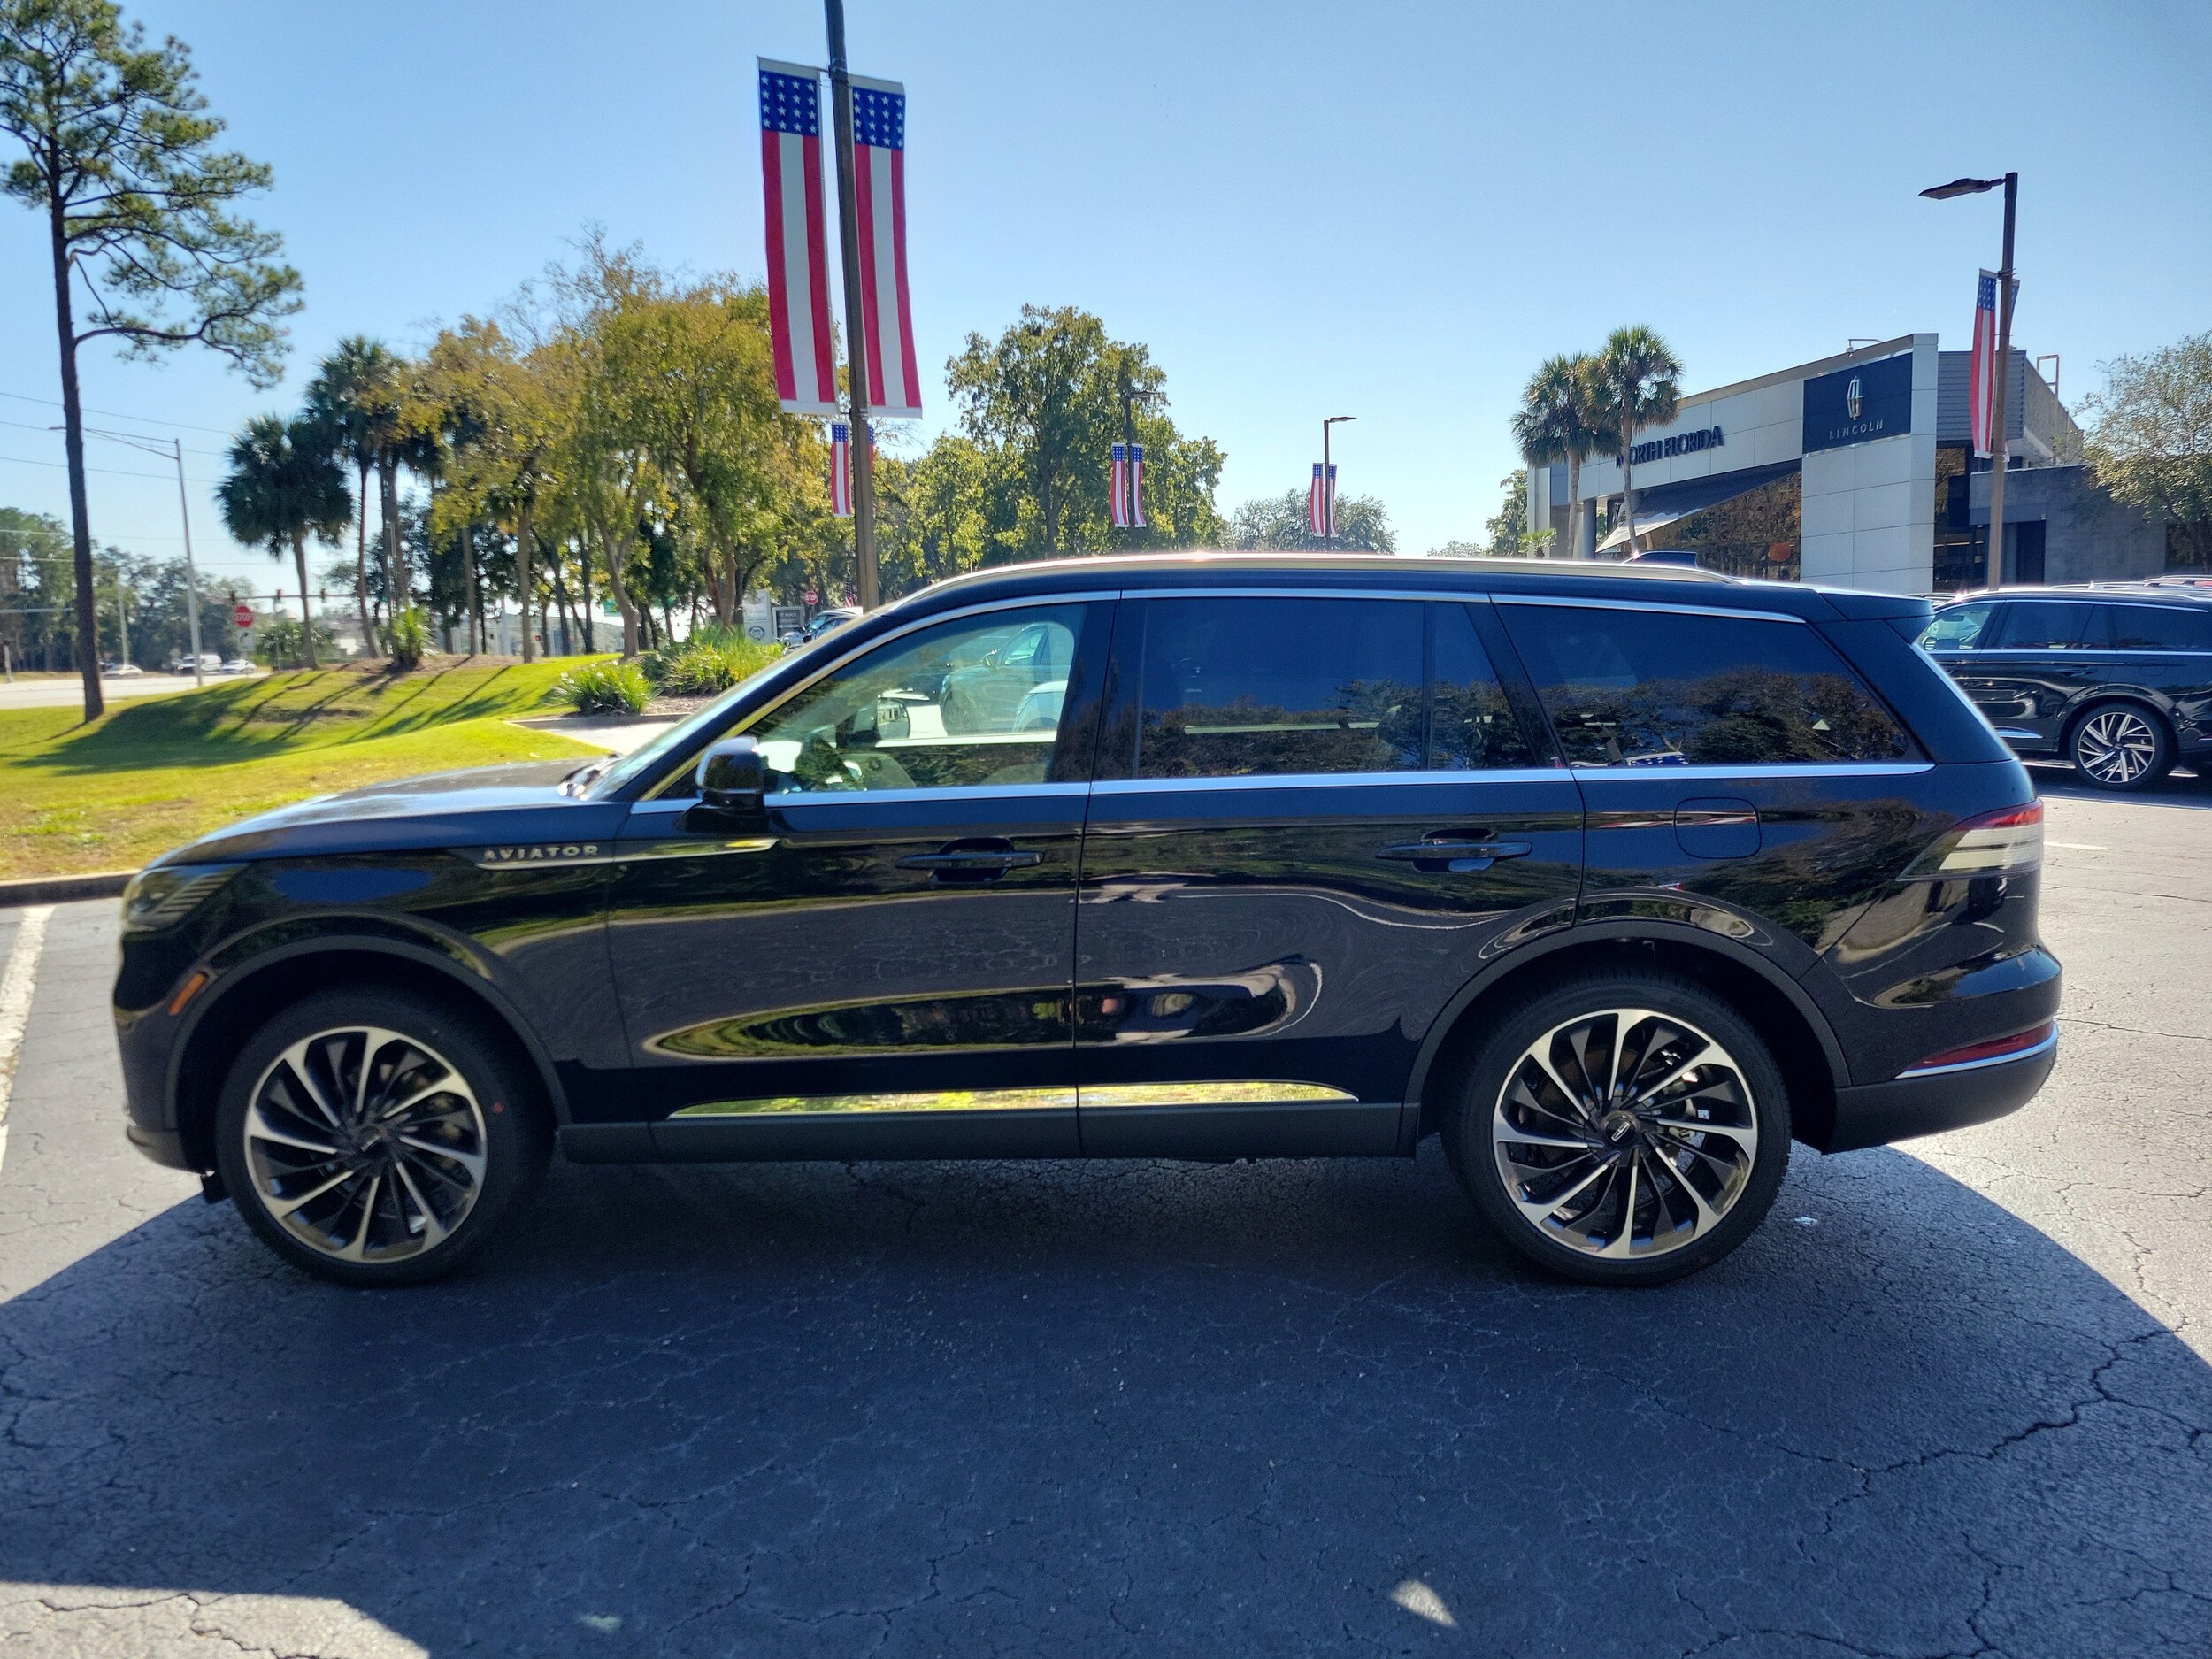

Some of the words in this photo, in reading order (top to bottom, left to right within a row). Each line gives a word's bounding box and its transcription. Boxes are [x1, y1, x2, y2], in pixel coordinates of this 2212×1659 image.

[1829, 419, 1884, 441] LINCOLN
[1663, 425, 1724, 458] FLORIDA
[235, 612, 253, 621] STOP
[483, 845, 599, 861] AVIATOR
